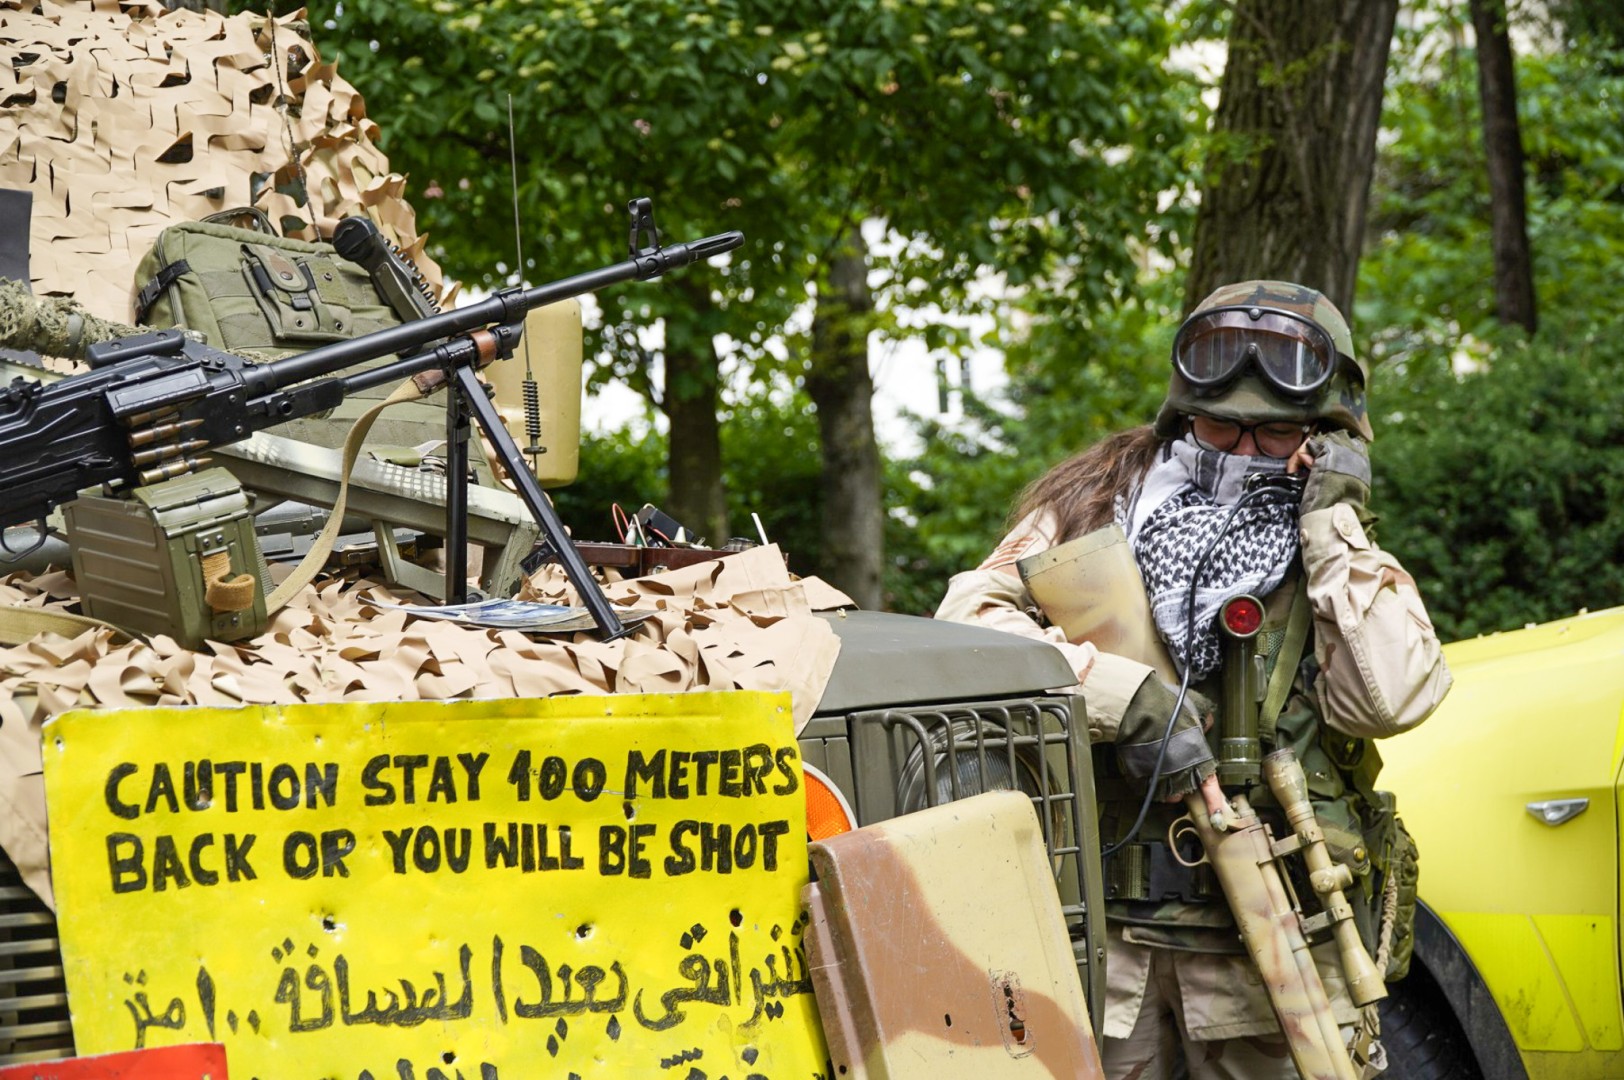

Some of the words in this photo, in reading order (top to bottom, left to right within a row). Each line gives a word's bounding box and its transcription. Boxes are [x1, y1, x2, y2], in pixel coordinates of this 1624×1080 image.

[105, 759, 339, 820] CAUTION
[361, 752, 489, 806] STAY
[507, 750, 607, 802] 100
[623, 743, 799, 800] METERS
[106, 832, 257, 893] BACK
[283, 829, 356, 880] OR
[383, 825, 472, 874] YOU
[483, 822, 584, 873] WILL
[599, 825, 657, 879] BE
[664, 819, 789, 876] SHOT
